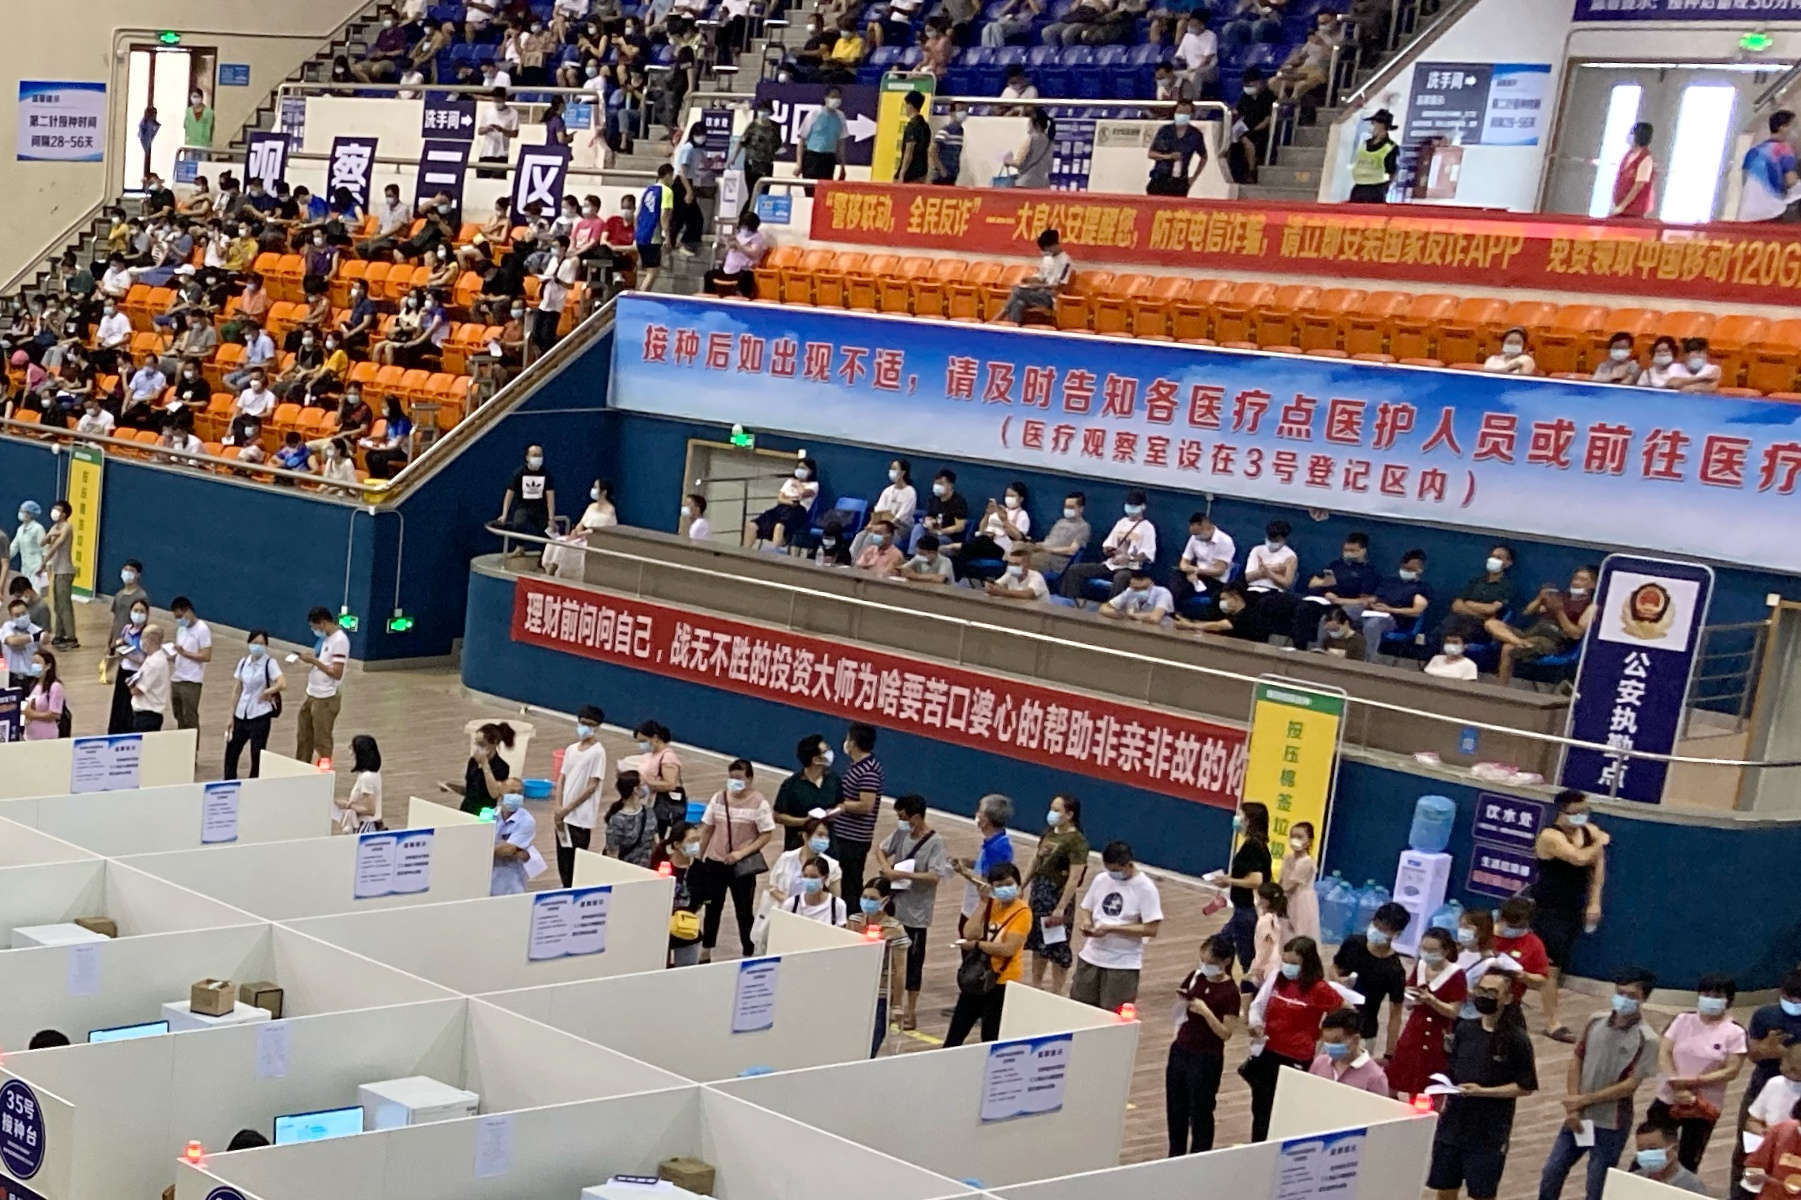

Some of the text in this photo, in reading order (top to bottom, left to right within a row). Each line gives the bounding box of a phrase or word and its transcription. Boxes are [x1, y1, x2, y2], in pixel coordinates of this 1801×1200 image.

[29, 115, 97, 129] 第二针接种时间
[424, 109, 460, 130] 洗手间
[31, 135, 94, 149] 间隔28-56天
[5, 1090, 35, 1121] 35号
[1, 1112, 38, 1148] 接种台
